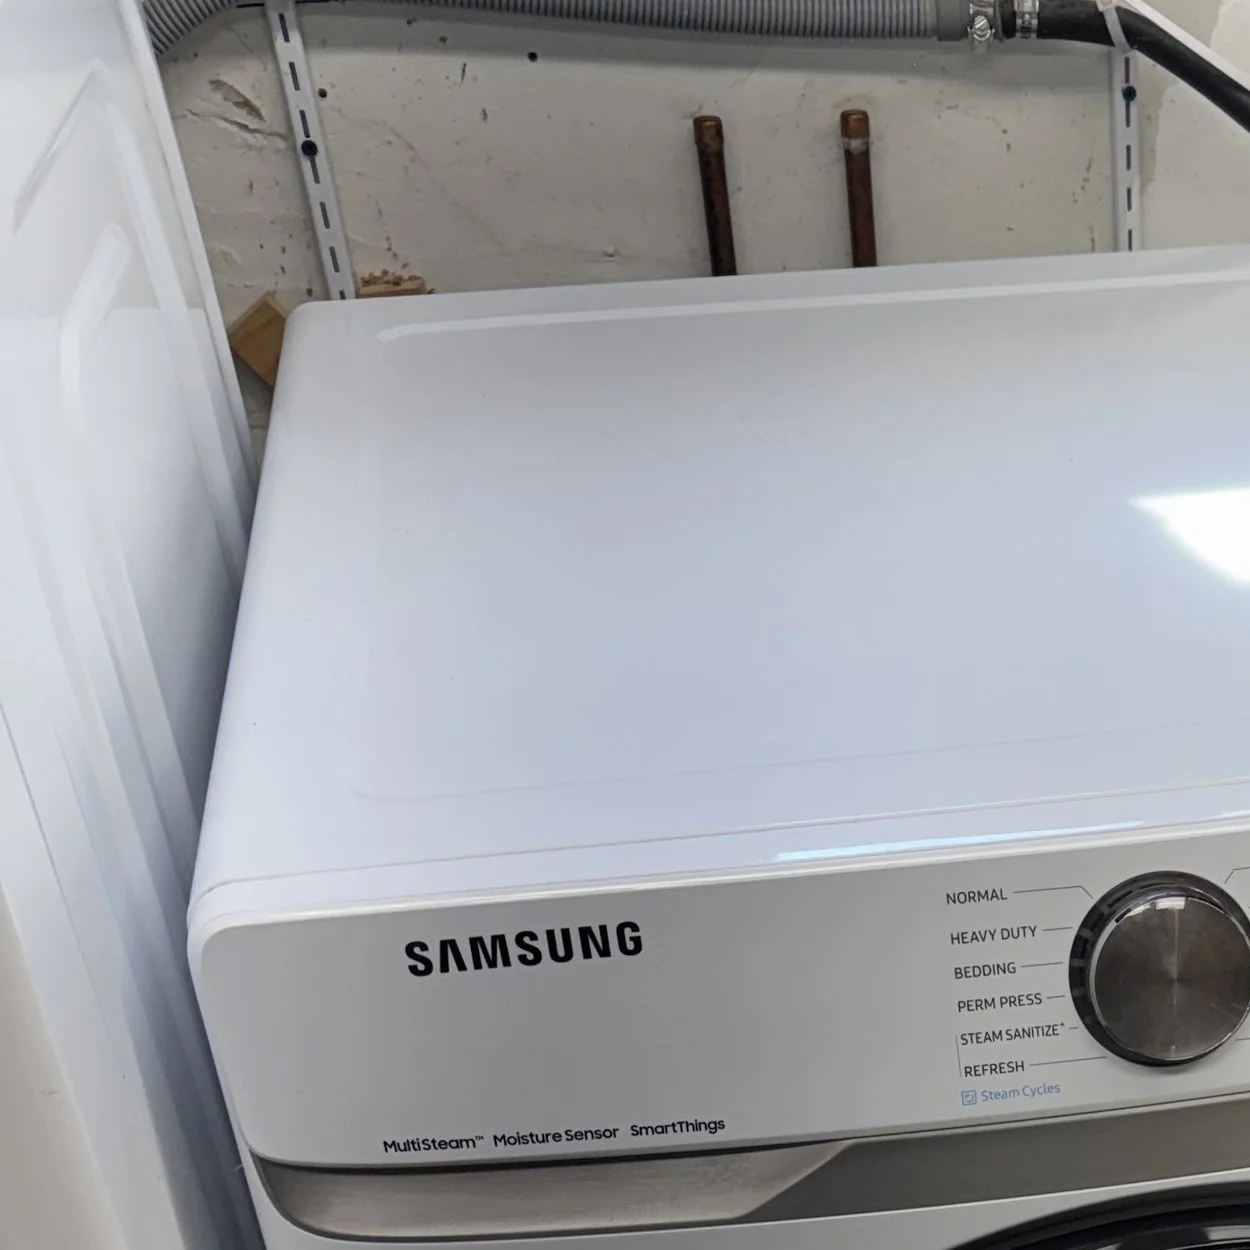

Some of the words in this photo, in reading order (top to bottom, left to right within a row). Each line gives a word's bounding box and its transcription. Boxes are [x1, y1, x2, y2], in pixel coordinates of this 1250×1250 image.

[946, 888, 1008, 905] NORMAL
[950, 929, 998, 945] HEAVY
[1001, 925, 1038, 942] DUTY
[404, 921, 643, 977] SAMSUNG
[954, 961, 1017, 980] BEDDING
[957, 997, 996, 1013] PERM
[999, 993, 1042, 1008] PRESS
[960, 1028, 1003, 1046] STEAM
[964, 1060, 1025, 1078] REFRESH
[980, 1085, 1020, 1102] Steam
[1022, 1081, 1060, 1100] Cycles
[493, 1129, 562, 1148] Moisture
[565, 1126, 620, 1142] Sensor
[630, 1118, 726, 1138] SmartThings
